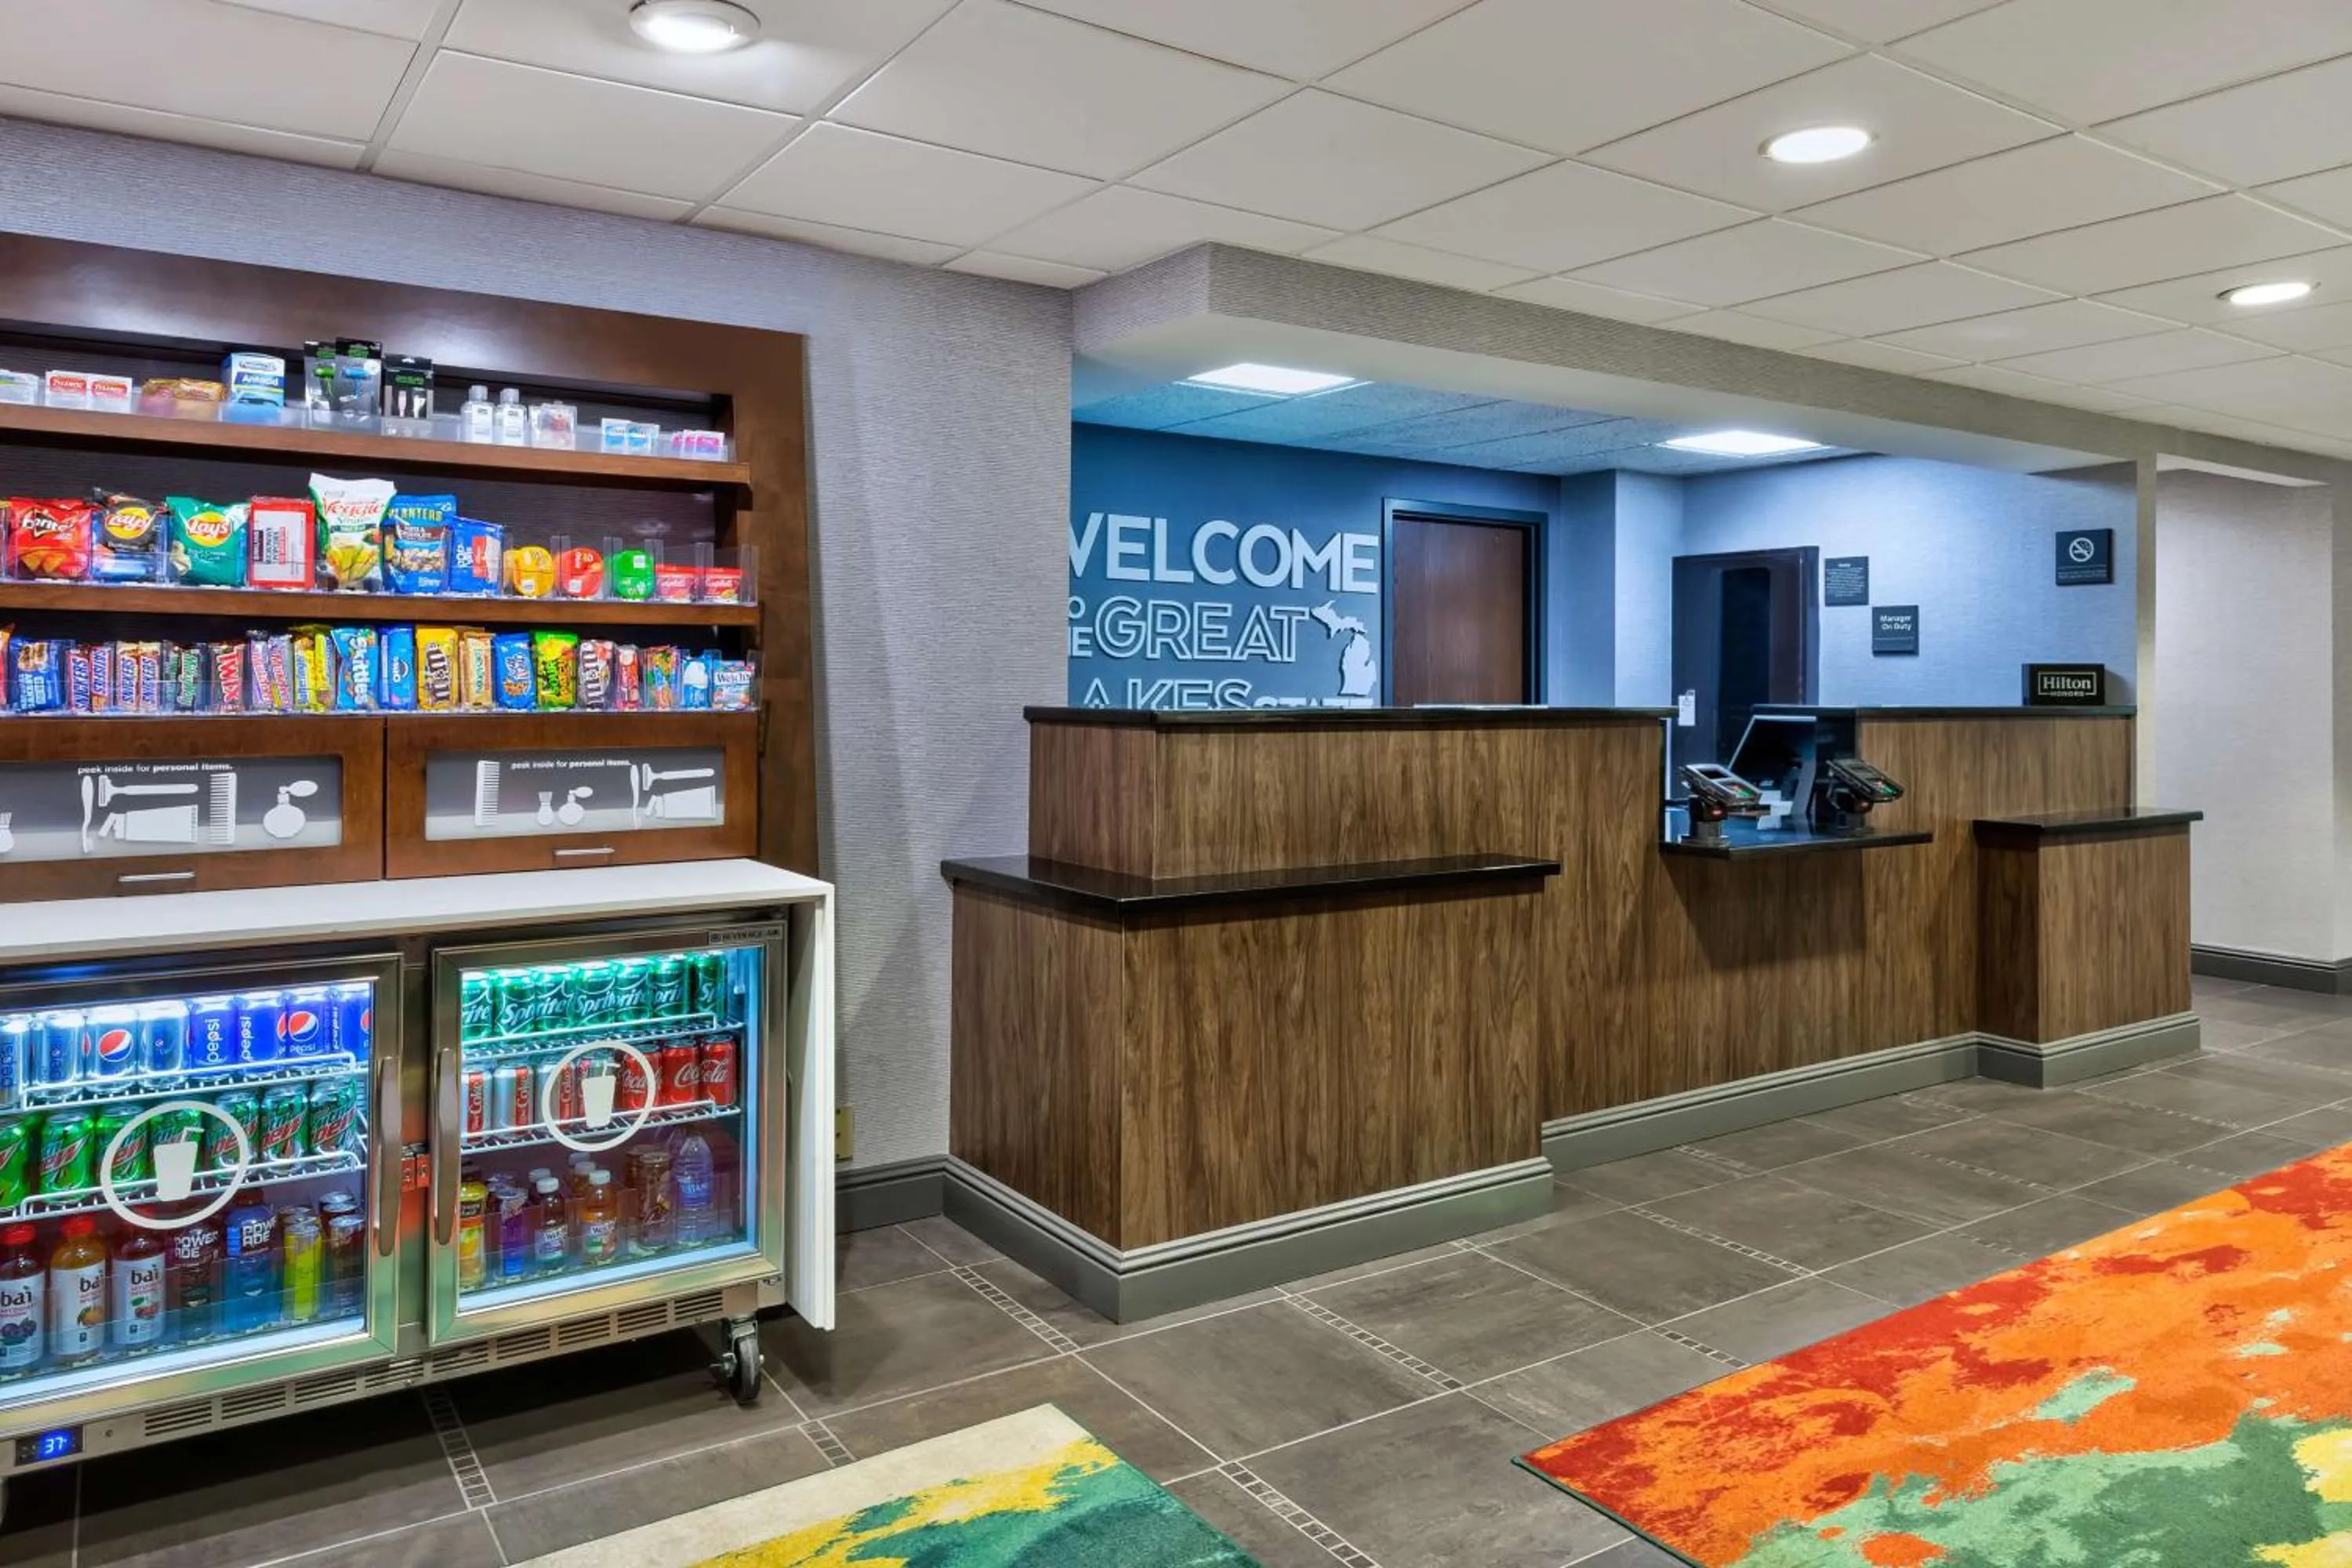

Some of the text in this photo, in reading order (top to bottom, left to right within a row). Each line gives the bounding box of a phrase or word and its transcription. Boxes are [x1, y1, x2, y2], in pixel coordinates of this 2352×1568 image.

[1880, 615, 1912, 623] Manager
[1095, 594, 1310, 663] GREAT
[2043, 677, 2092, 690] Hilton
[78, 766, 102, 775] peek
[104, 764, 133, 773] inside
[136, 764, 150, 772] for
[152, 763, 198, 774] personal
[568, 759, 604, 769] personal
[205, 1018, 220, 1062] pepsi
[239, 1016, 255, 1060] pepsi
[289, 1044, 316, 1055] pepsi
[130, 1264, 159, 1285] bai
[1, 1286, 33, 1308] bai
